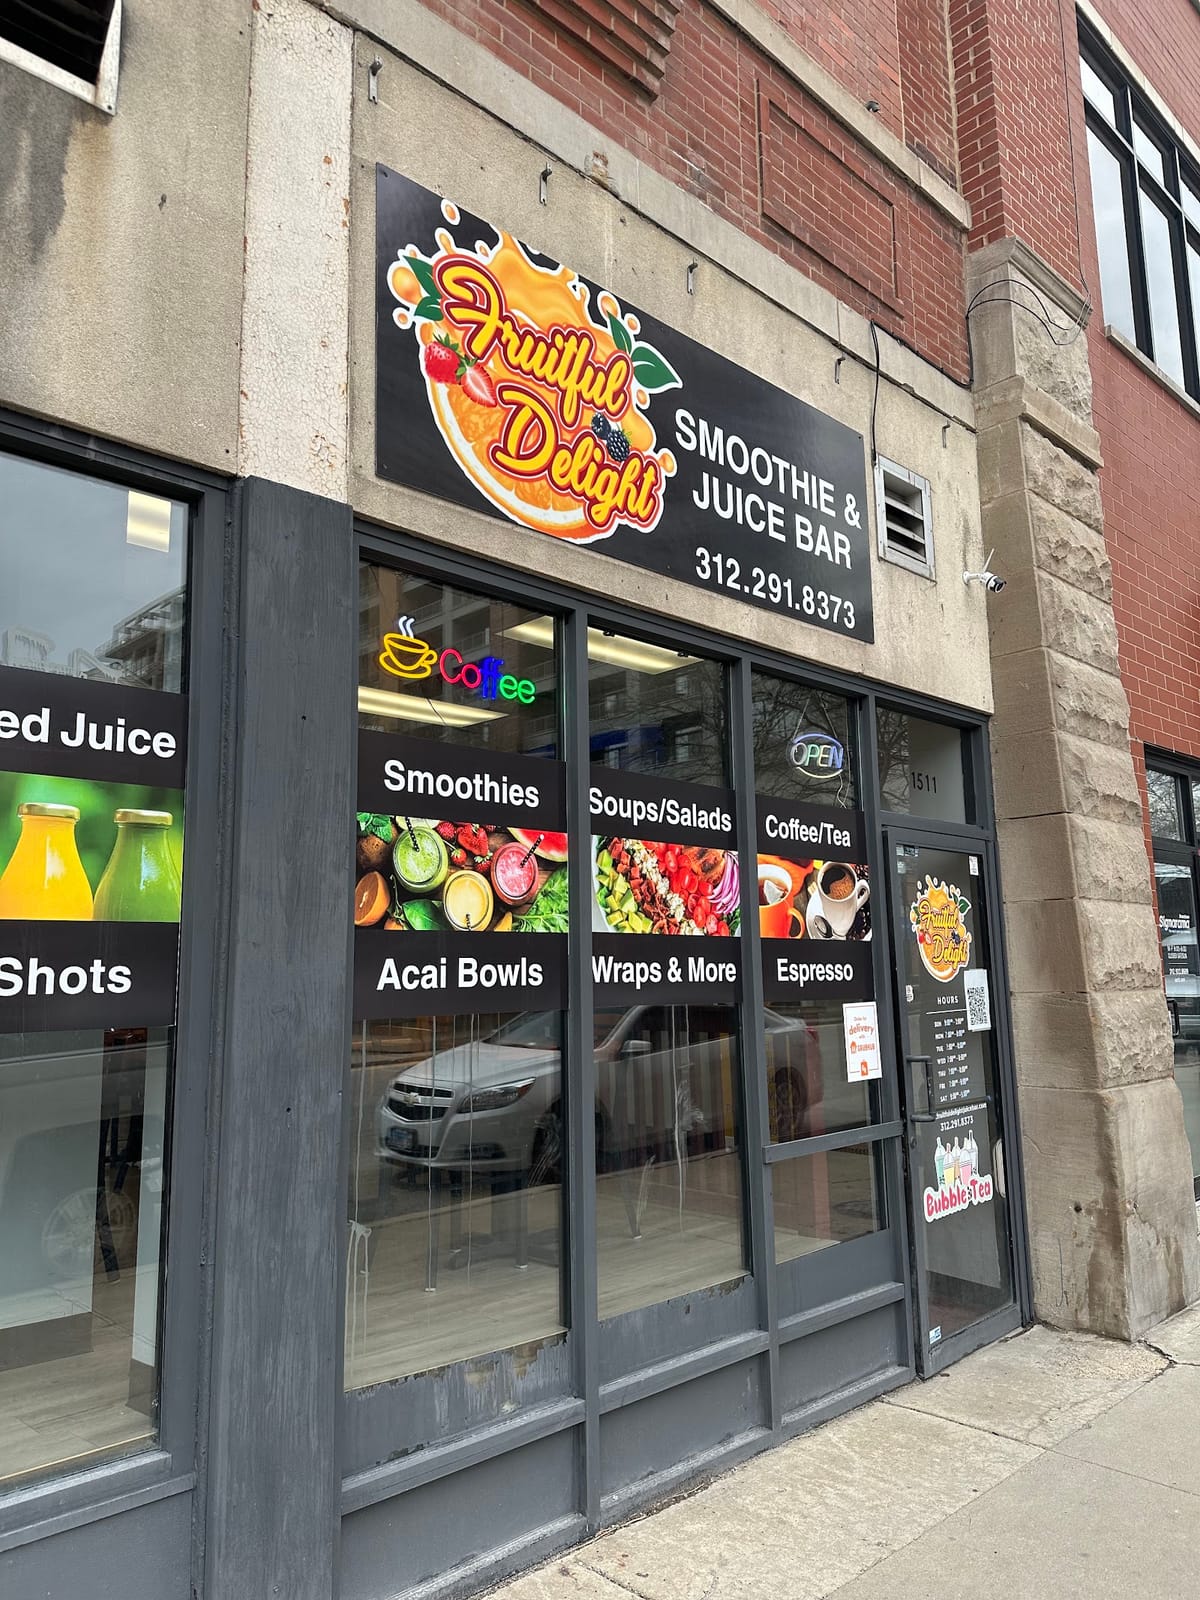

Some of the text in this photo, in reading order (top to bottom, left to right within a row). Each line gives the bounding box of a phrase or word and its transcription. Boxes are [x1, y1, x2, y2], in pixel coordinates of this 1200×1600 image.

[433, 255, 633, 424] Fruitful
[492, 386, 658, 528] Delight
[675, 408, 863, 530] SMOOTHIE &
[692, 472, 854, 569] JUICE BAR
[695, 548, 856, 630] 312.291.8373
[439, 648, 536, 705] Coffee
[0, 707, 177, 759] ed Juice
[790, 742, 845, 770] OPEN
[384, 759, 540, 808] Smoothies
[911, 771, 938, 794] 1511
[588, 786, 732, 833] Soups/Salads
[765, 814, 852, 848] Coffee/Tea
[918, 898, 959, 937] Fruitful
[932, 934, 967, 969] Delight
[0, 957, 133, 997] Shots
[376, 957, 544, 991] Acai Bowls
[591, 956, 737, 989] Wraps & More
[777, 958, 853, 986] Espresso
[937, 996, 959, 1005] HOURS
[926, 1179, 991, 1217] Bubble Tea
